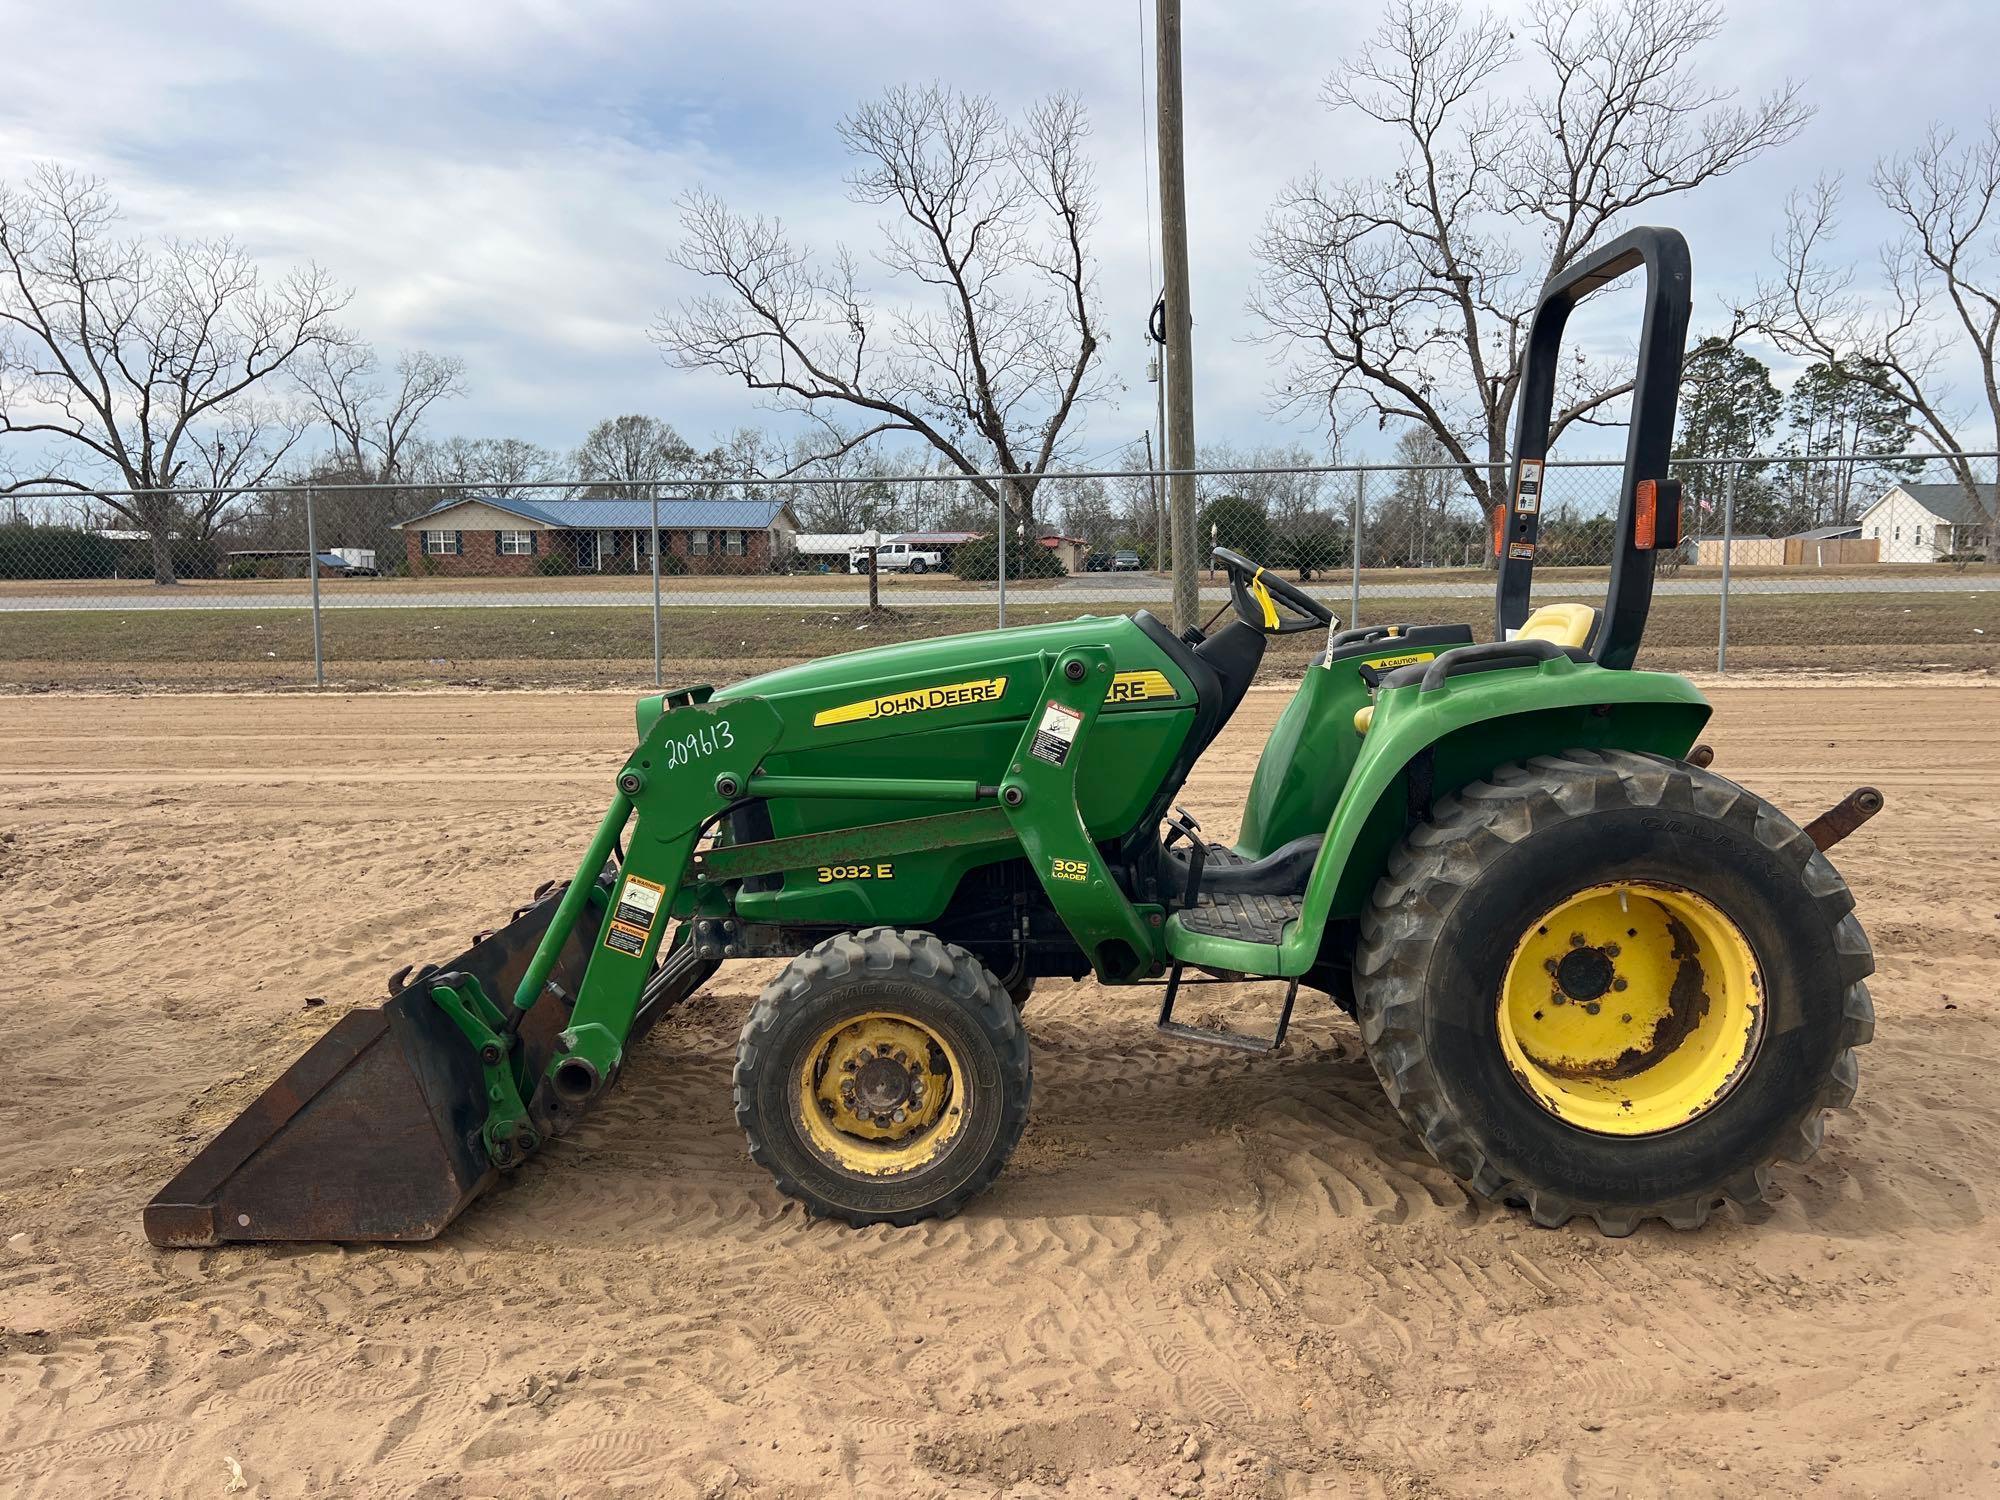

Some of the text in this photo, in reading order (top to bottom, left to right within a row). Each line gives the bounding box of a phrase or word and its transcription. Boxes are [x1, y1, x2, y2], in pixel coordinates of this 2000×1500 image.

[1388, 657, 1418, 666] CAUTION
[1106, 681, 1146, 700] RE
[869, 684, 998, 717] JOHN DEERE
[665, 720, 735, 769] 209613
[818, 863, 893, 883] 3032 E
[1054, 860, 1087, 874] 305
[1052, 871, 1086, 881] LOADER
[636, 879, 660, 891] WARNING
[621, 926, 644, 937] WARNING
